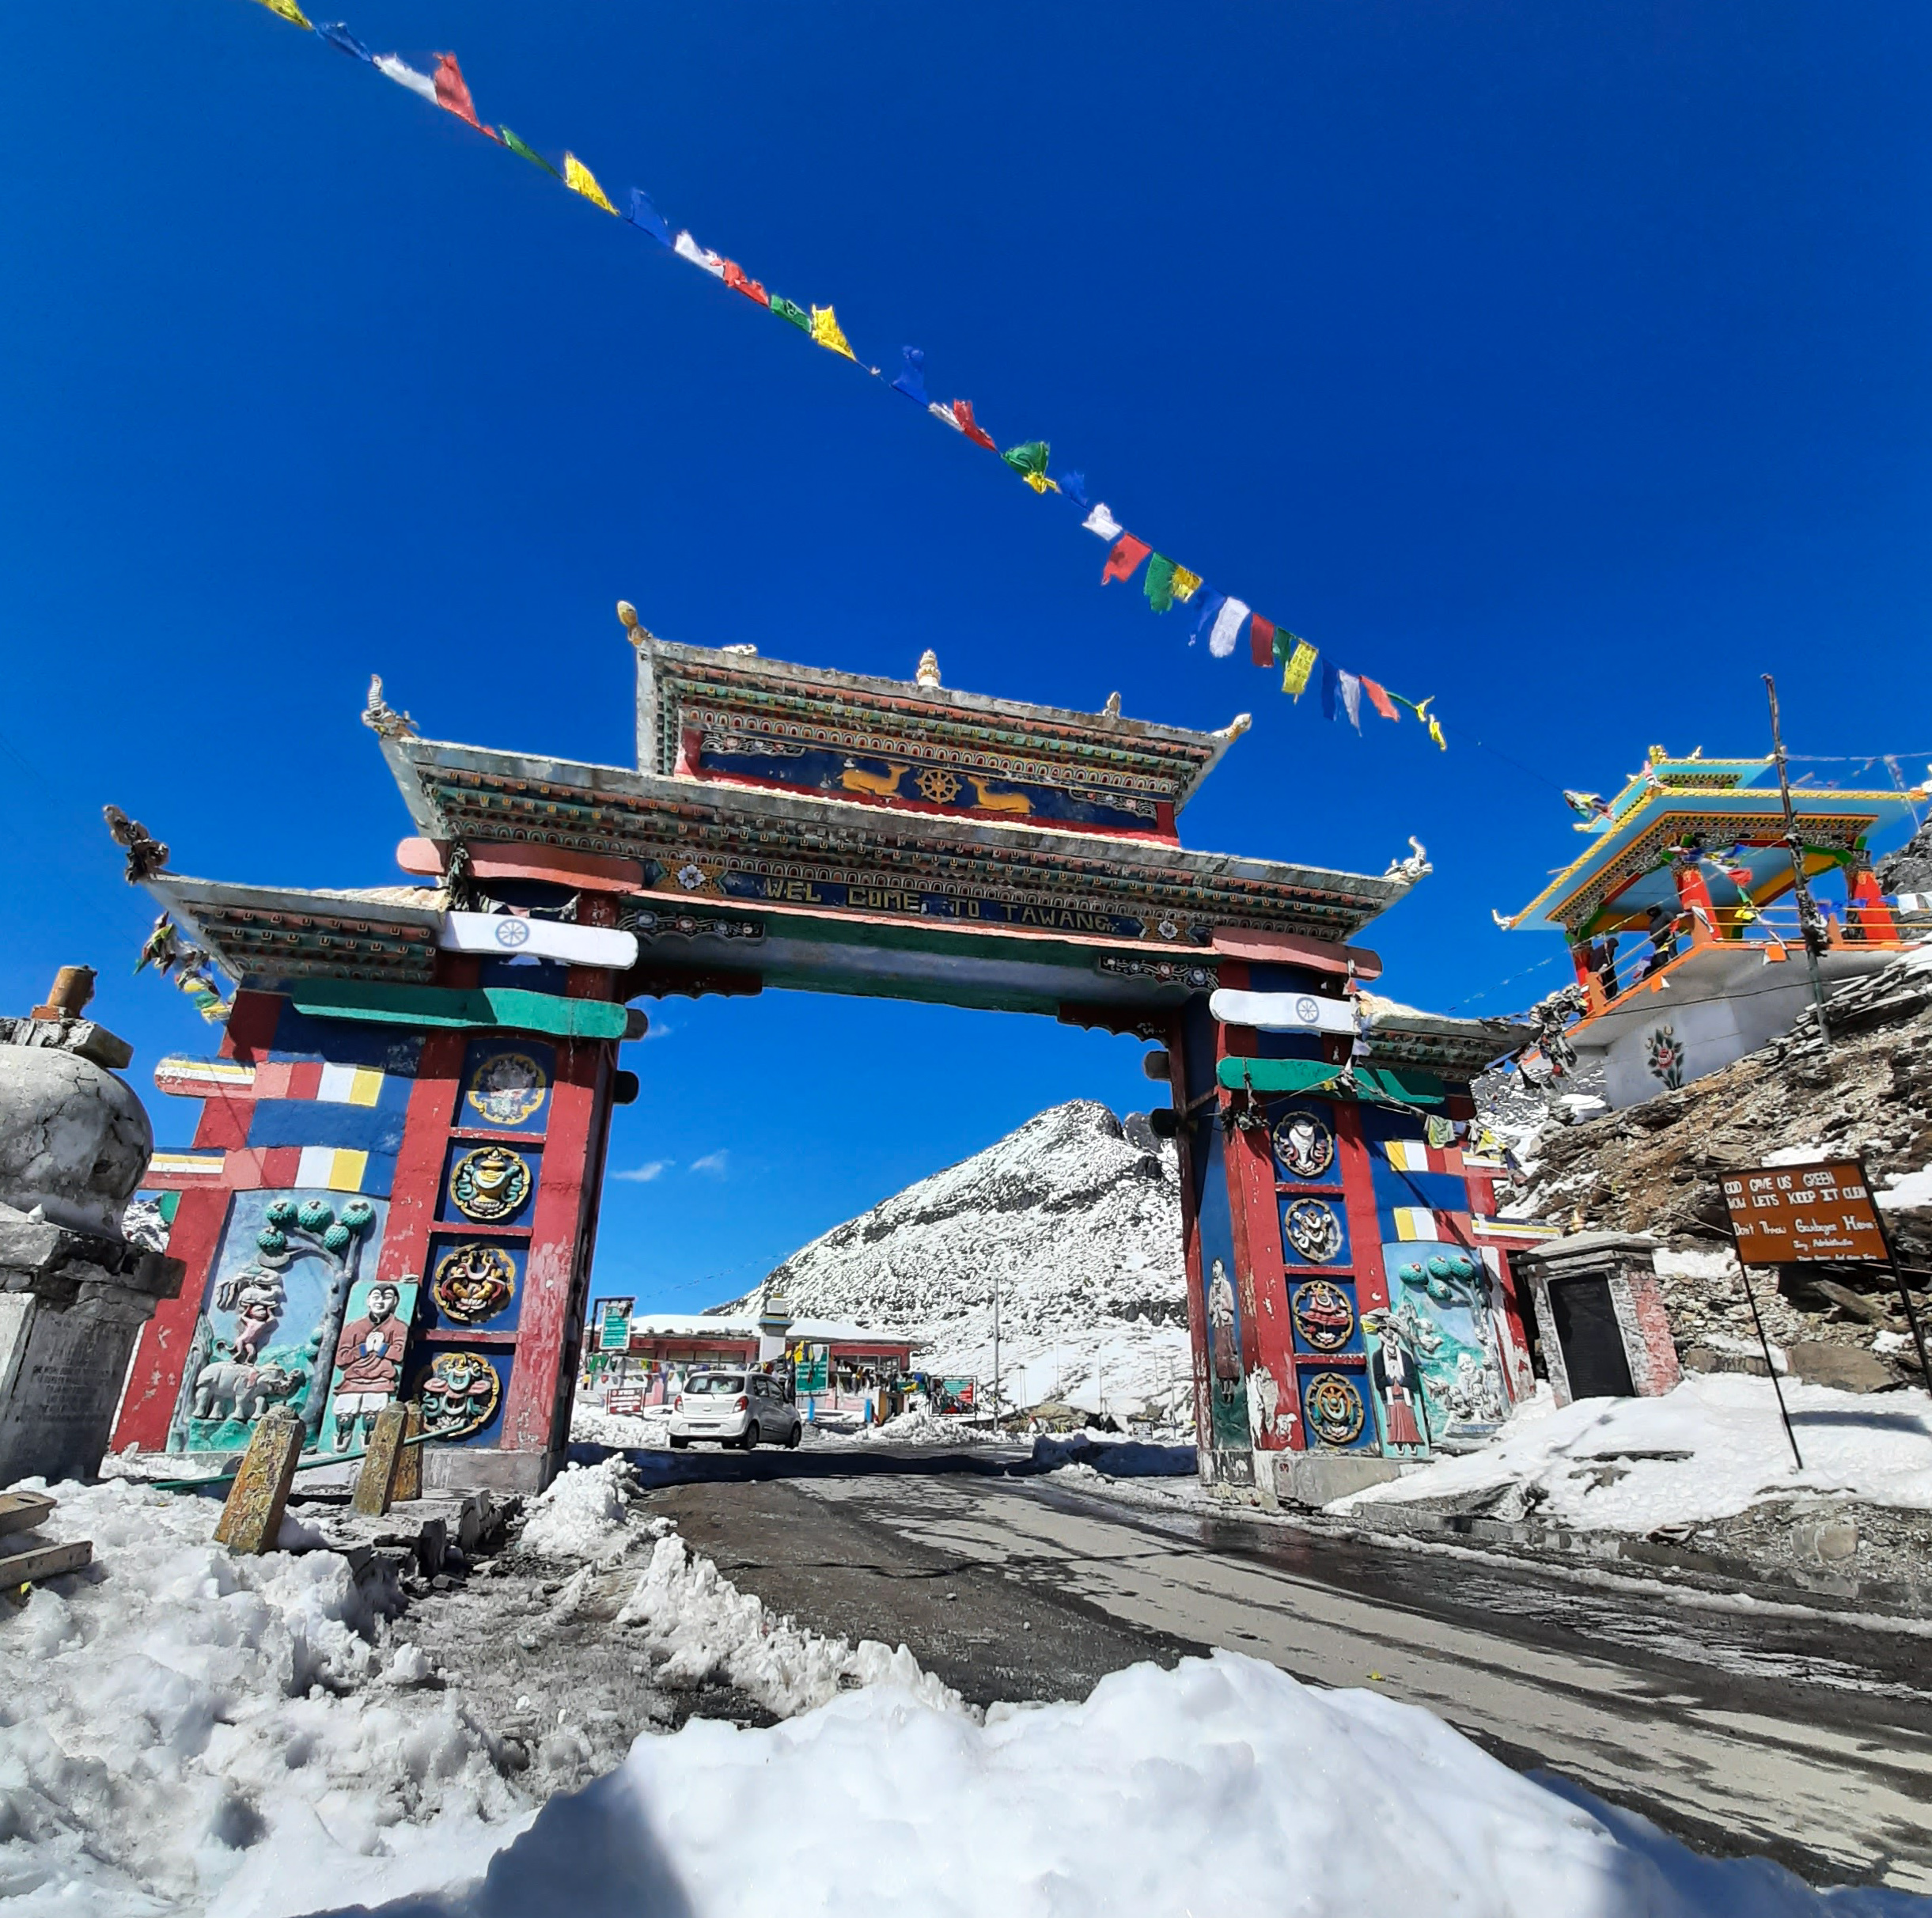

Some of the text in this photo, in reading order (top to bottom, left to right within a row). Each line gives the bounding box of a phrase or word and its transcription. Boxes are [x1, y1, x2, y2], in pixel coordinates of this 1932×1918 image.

[766, 878, 1111, 932] WEL COME TO TAWANG
[1724, 1181, 1743, 1194] GOD
[1777, 1175, 1793, 1189] US
[1803, 1172, 1835, 1187] GREEN
[1752, 1194, 1779, 1207] LETS
[1786, 1190, 1816, 1204] KEEP
[1820, 1188, 1839, 1201] IT
